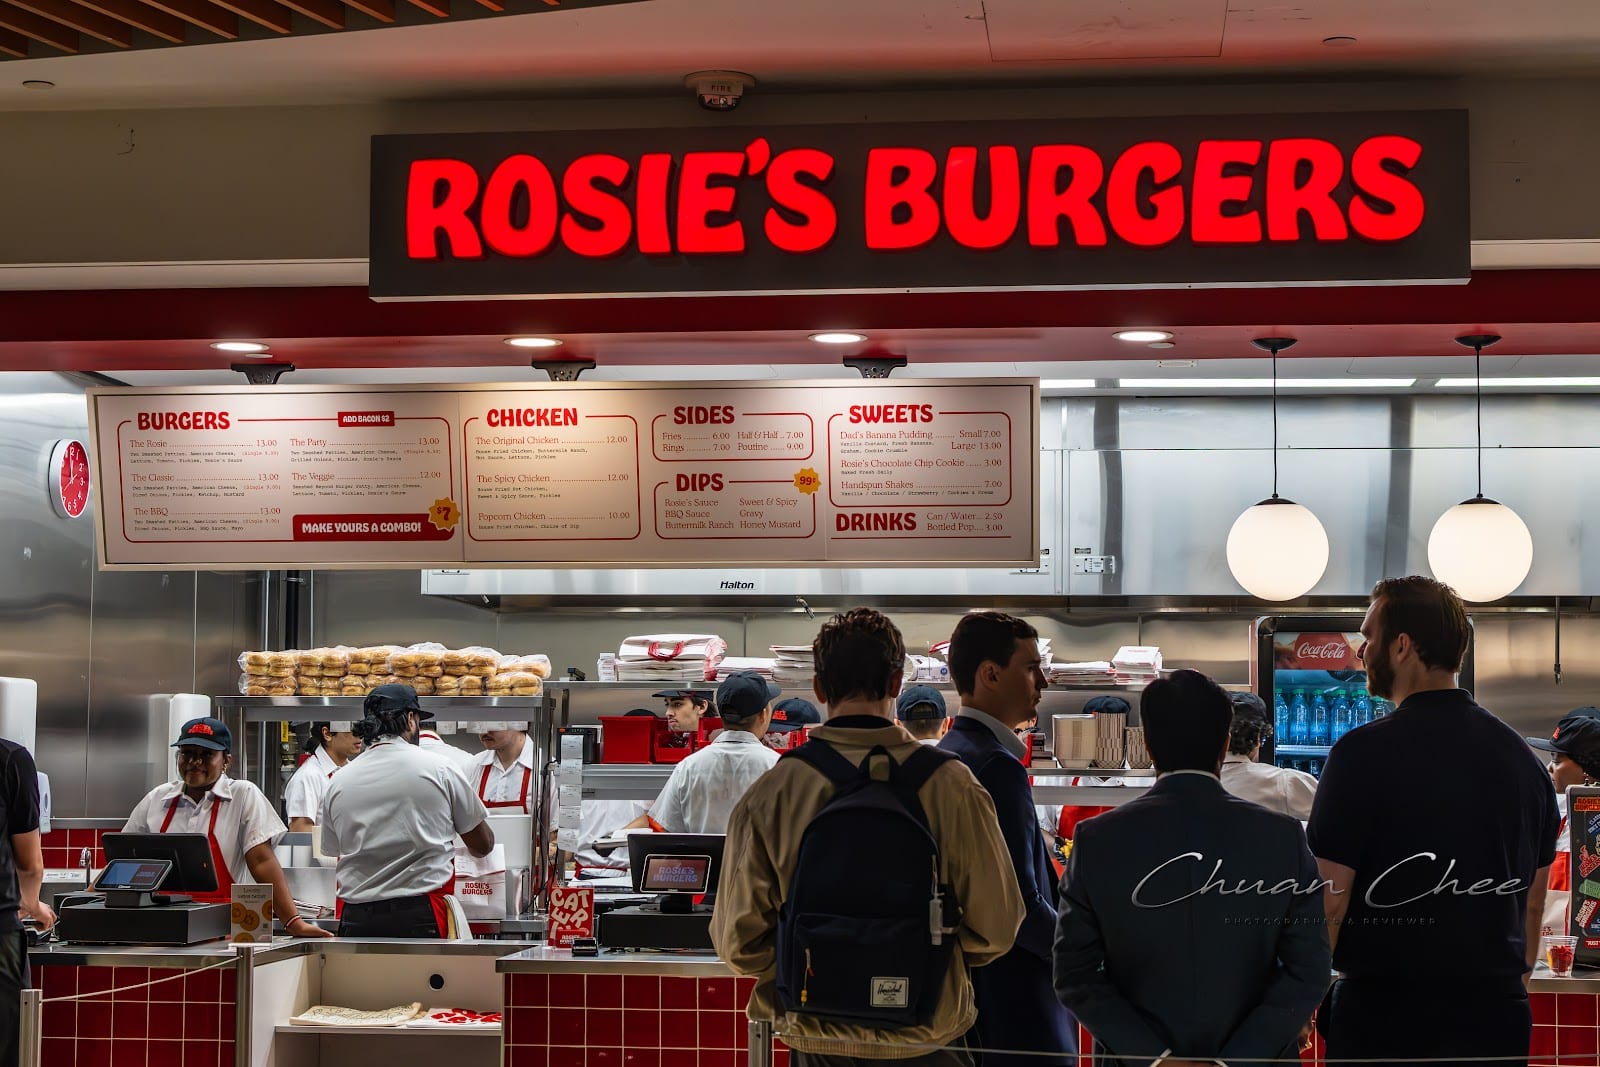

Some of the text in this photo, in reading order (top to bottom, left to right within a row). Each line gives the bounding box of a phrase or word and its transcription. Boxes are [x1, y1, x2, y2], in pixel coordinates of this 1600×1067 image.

[406, 130, 1426, 259] ROSIE'S BURGERS
[487, 408, 578, 427] CHICKEN
[674, 406, 735, 425] SIDES
[850, 404, 933, 423] SWEETS
[138, 412, 231, 430] BURGERS
[662, 432, 682, 440] Fries
[737, 431, 753, 439] Half
[754, 431, 762, 439] &
[763, 431, 778, 439] Half
[840, 431, 863, 439] Dad's
[866, 431, 896, 439] Banana
[899, 431, 933, 440] Pudding
[959, 430, 982, 438] Small
[130, 440, 145, 448] The
[147, 440, 167, 448] Rosie
[308, 438, 327, 447] Party
[493, 437, 525, 446] Original
[527, 436, 559, 444] Chicken
[663, 443, 730, 453] Rings 7.00
[951, 442, 1002, 451] Large 13.00
[841, 459, 1002, 468] Rosie's Chocolate Chip Cookie 3.00
[292, 472, 307, 480] The
[309, 473, 334, 481] Veggie
[477, 475, 492, 483] The
[494, 475, 515, 484] Spicy
[518, 474, 550, 482] Chicken
[676, 473, 723, 492] DIPS
[841, 481, 883, 490] Handspun
[885, 480, 914, 488] Shakes
[665, 499, 692, 507] Rosie's
[739, 498, 798, 507] Sweet & Spicy
[134, 508, 148, 516] The
[151, 508, 168, 516] BBQ
[436, 506, 451, 520] $7
[665, 510, 683, 518] BBQ
[740, 510, 763, 518] Gravy
[951, 512, 975, 520] Water
[478, 513, 511, 522] Popcorn
[514, 512, 546, 520] Chicken
[836, 512, 917, 531] DRINKS
[302, 522, 422, 533] MAKE YOURS A COMBO!
[665, 521, 707, 529] Buttermilk
[740, 520, 801, 529] Honey Mustard
[927, 523, 1003, 532] Bottled Pop 3.00
[720, 581, 754, 589] Halton
[1297, 642, 1346, 658] Coca-Cola
[551, 889, 590, 911] CAT
